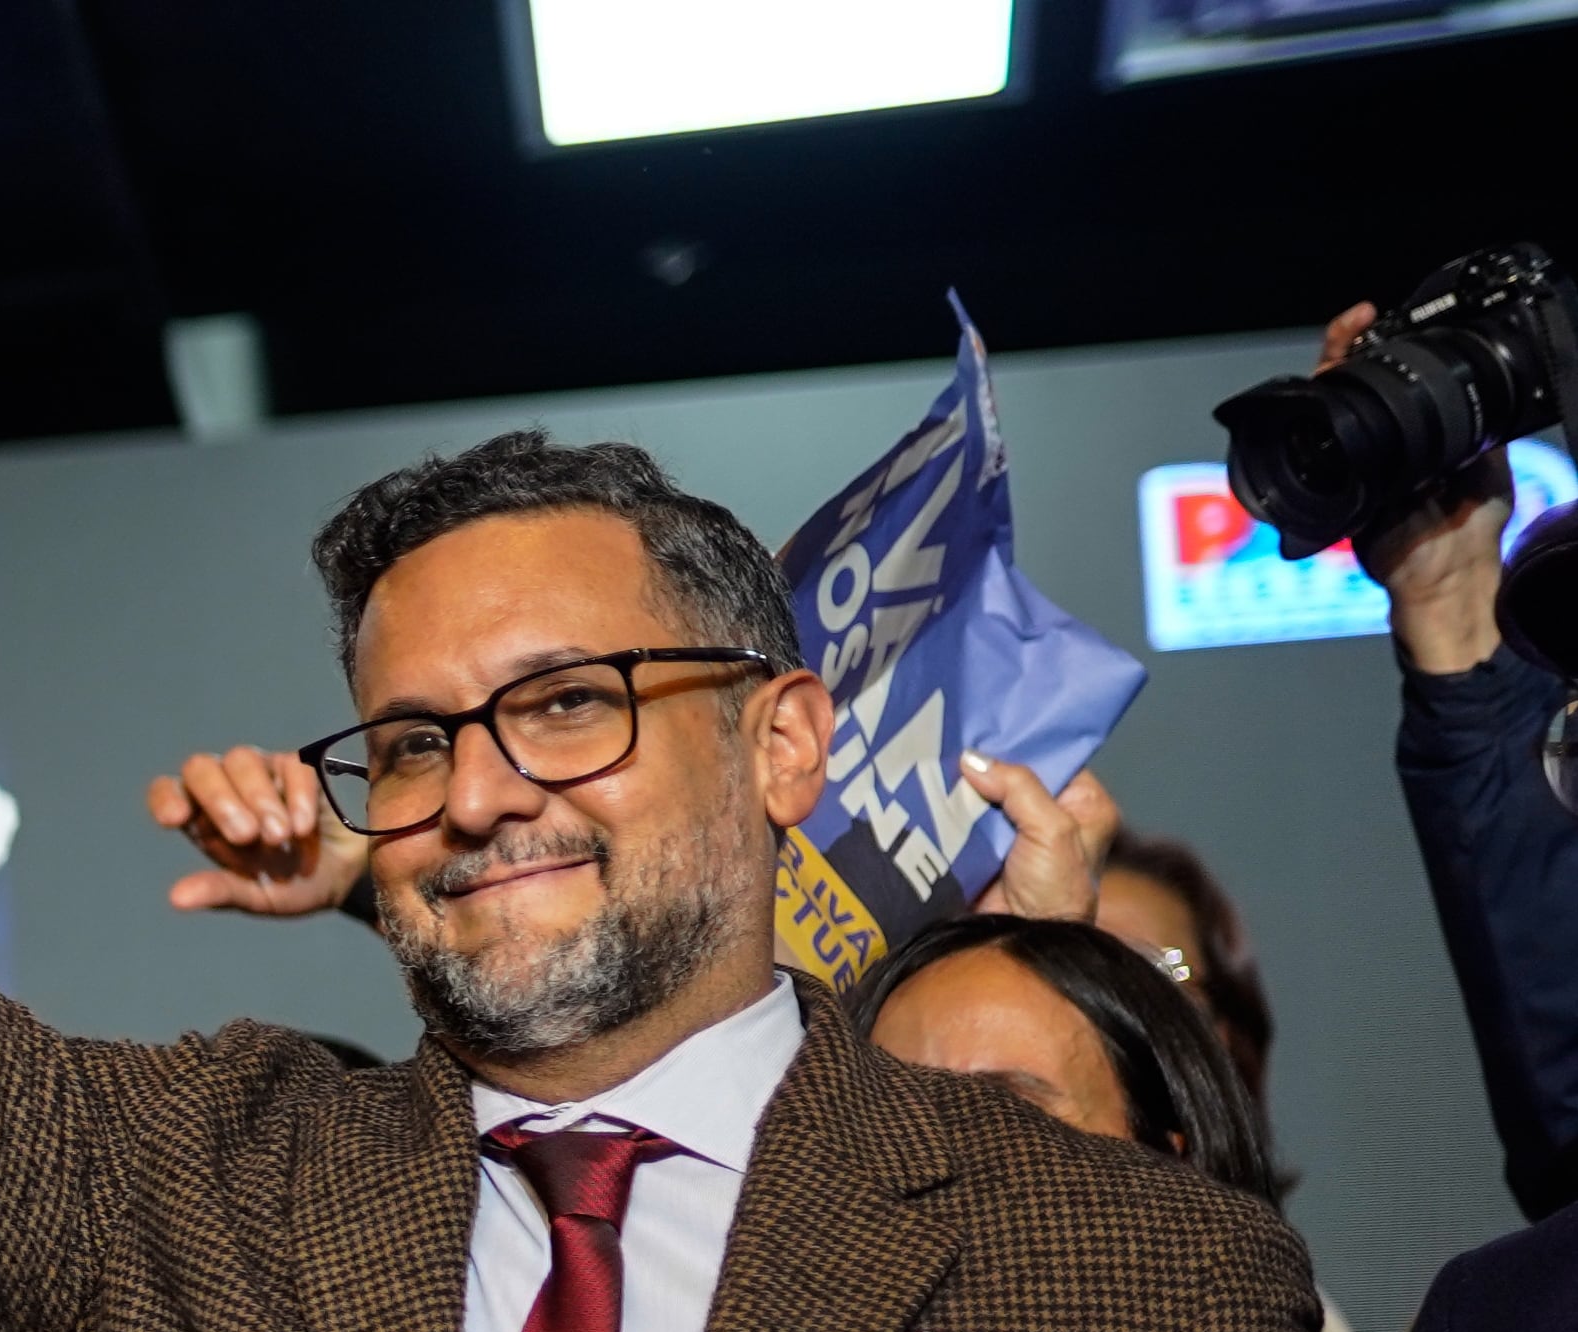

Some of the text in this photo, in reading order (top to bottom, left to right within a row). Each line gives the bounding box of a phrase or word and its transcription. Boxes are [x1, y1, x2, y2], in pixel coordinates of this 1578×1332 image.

[817, 466, 949, 903] NOS UNE
[850, 396, 990, 866] IVÁN
